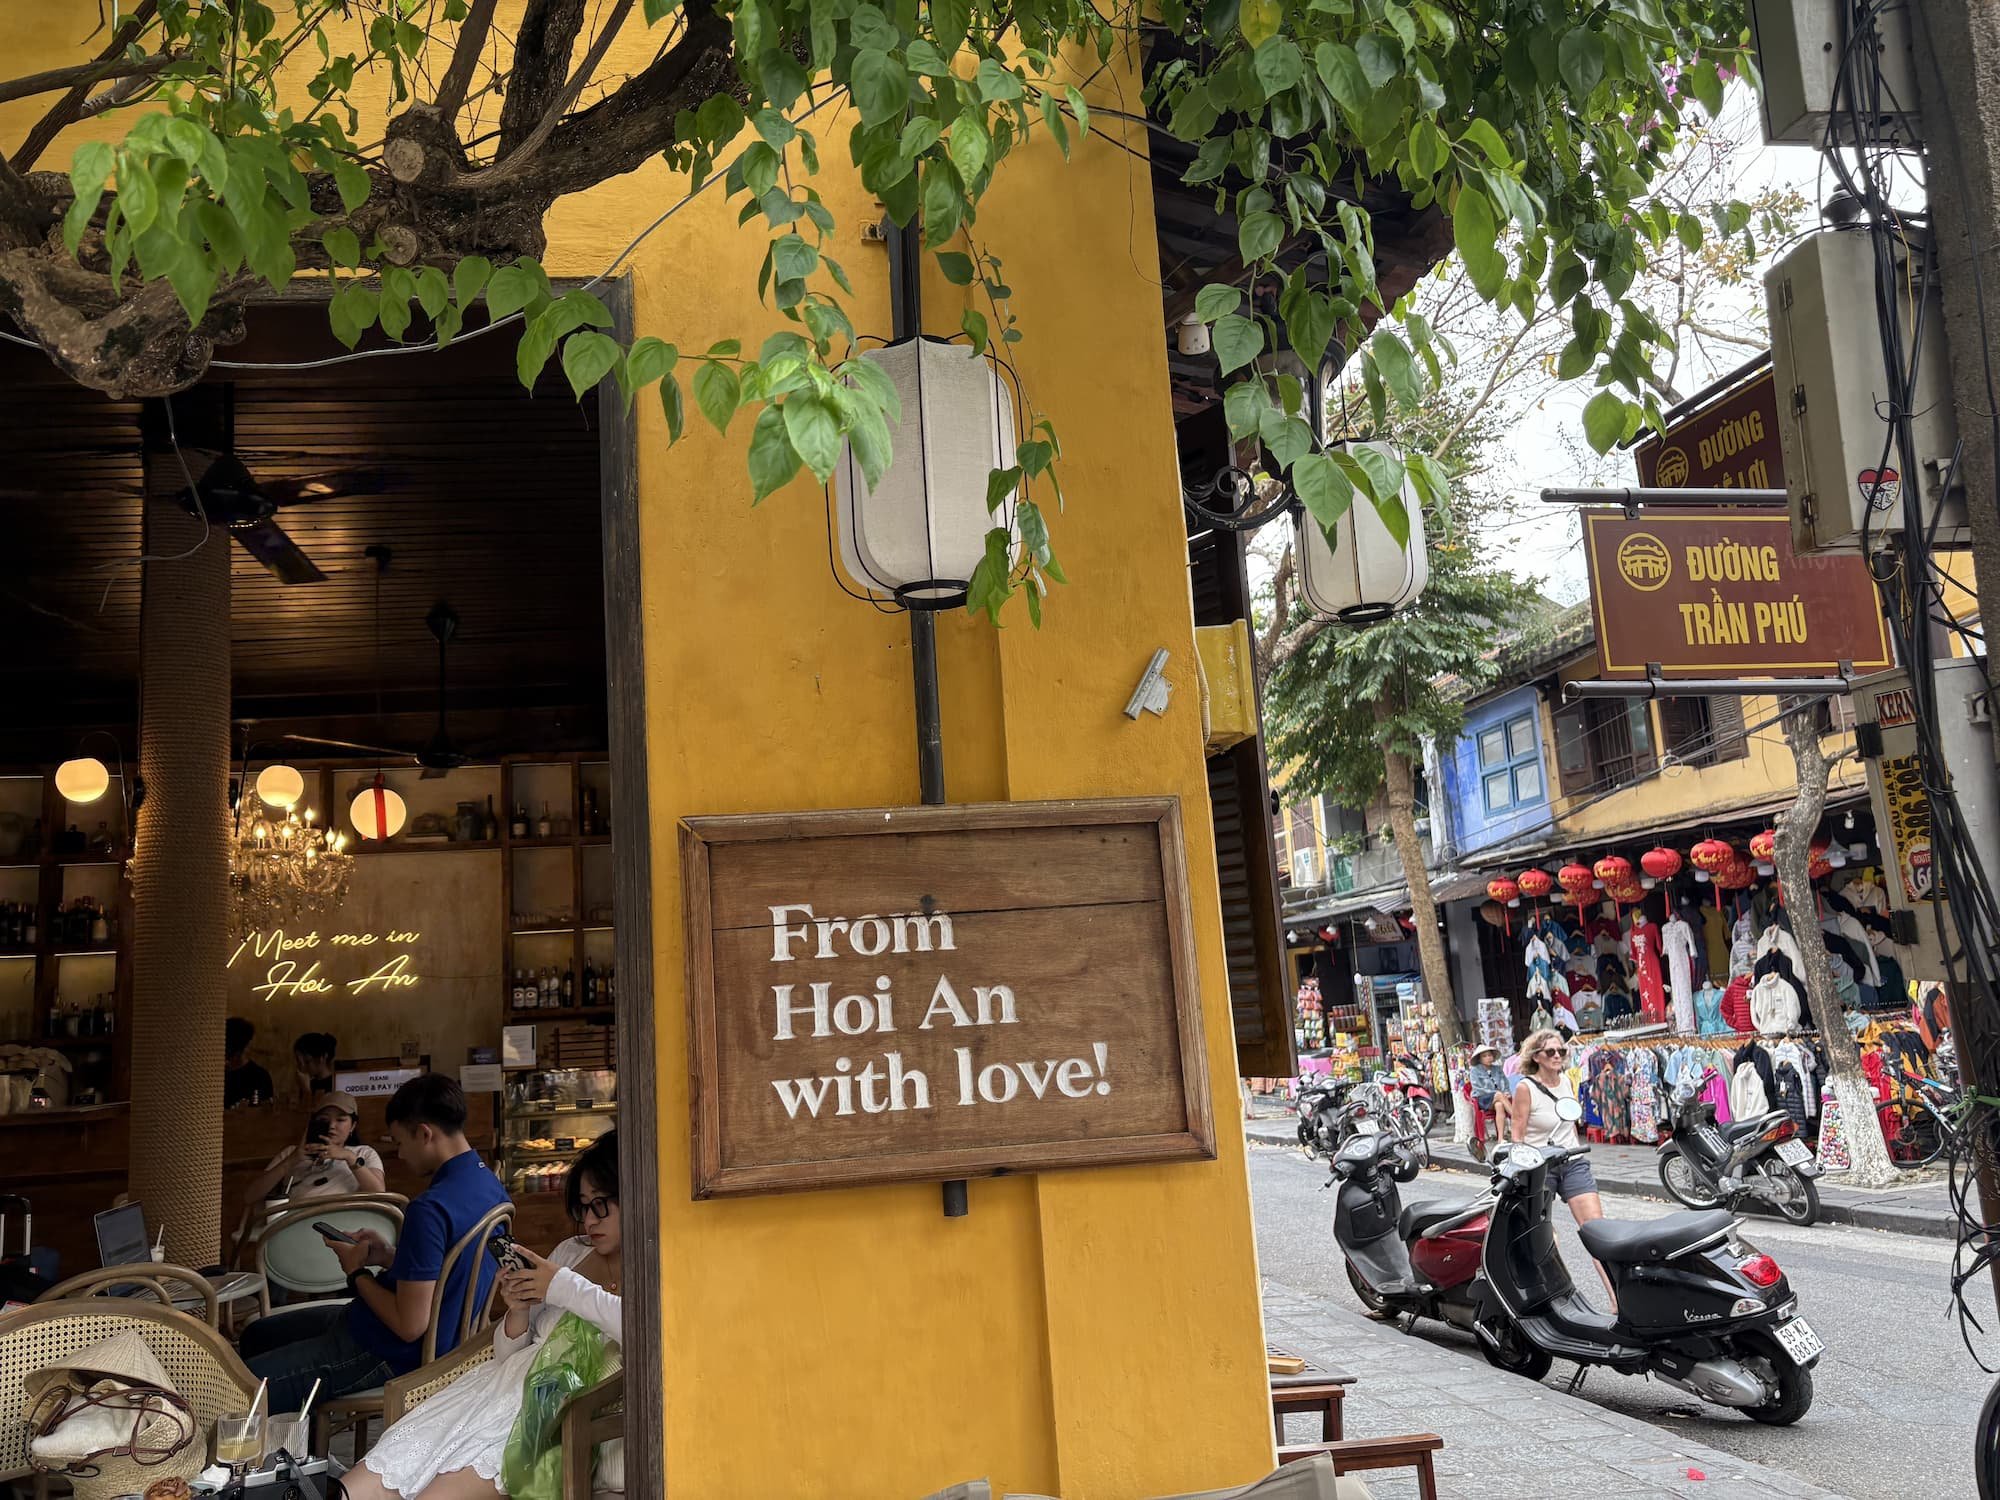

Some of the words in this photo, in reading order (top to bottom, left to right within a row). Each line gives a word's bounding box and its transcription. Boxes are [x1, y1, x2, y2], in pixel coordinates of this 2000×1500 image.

[1699, 410, 1765, 470] ĐƯỜNG
[1686, 537, 1780, 582] ĐƯỜNG
[1679, 588, 1748, 645] TRẦN
[1754, 594, 1808, 644] PHÚ
[226, 929, 320, 968] Meet
[331, 933, 379, 946] me
[386, 930, 420, 943] in
[767, 902, 958, 962] From
[252, 960, 333, 1001] Hoi
[347, 955, 419, 995] An
[771, 975, 898, 1041] Hoi
[918, 974, 1020, 1030] An
[345, 1084, 369, 1092] ORDER
[771, 1050, 934, 1119] with
[953, 1041, 1111, 1106] love!
